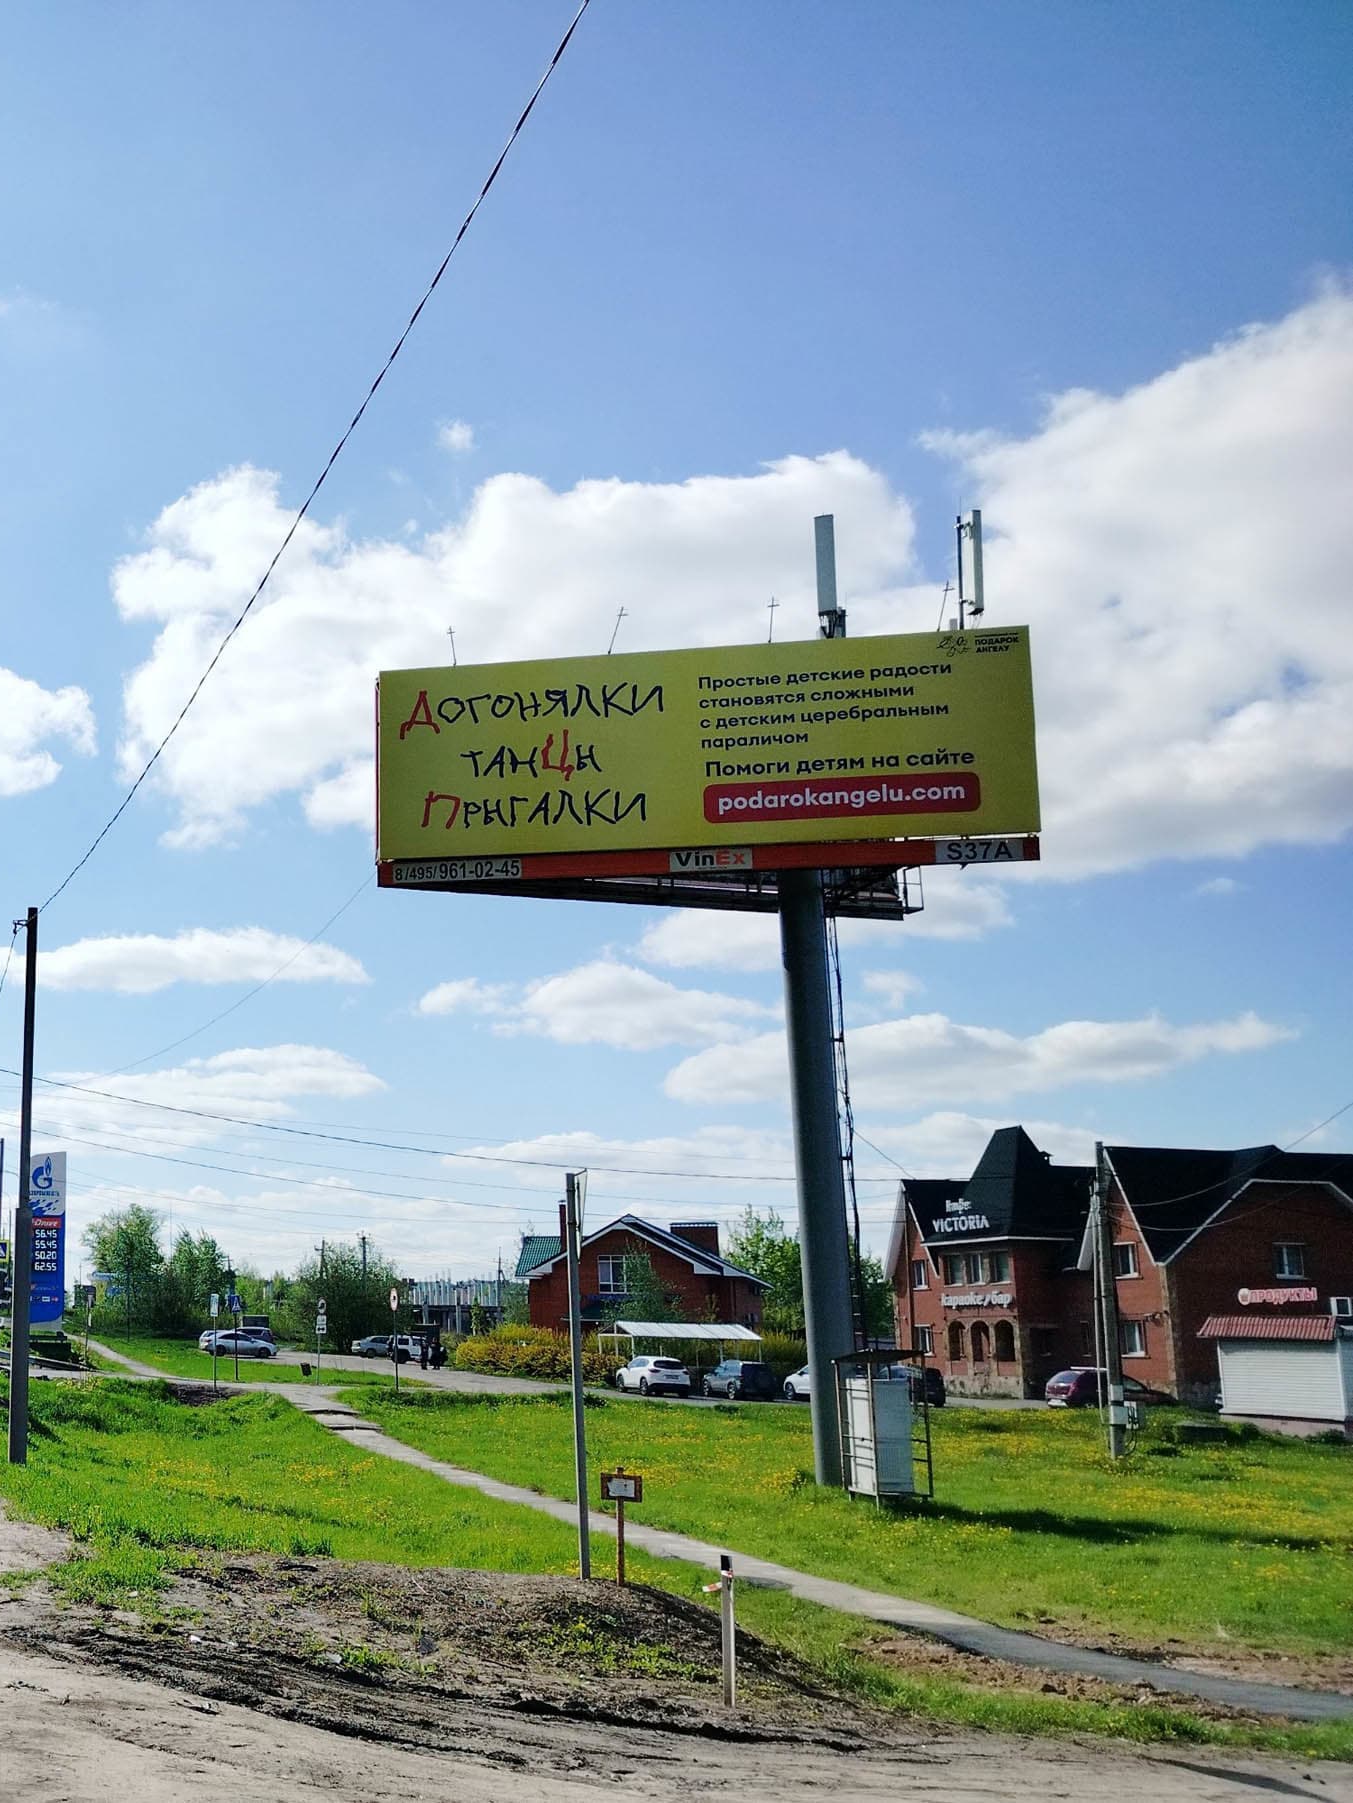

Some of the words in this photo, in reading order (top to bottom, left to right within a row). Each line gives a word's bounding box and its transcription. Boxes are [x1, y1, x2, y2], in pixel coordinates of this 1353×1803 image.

[974, 635, 1019, 645] ПОДАРОК
[975, 644, 1010, 653] АНГЕЛУ
[698, 674, 781, 692] Простые
[786, 668, 865, 685] детские
[869, 663, 952, 681] радости
[699, 692, 806, 709] становятся
[810, 686, 914, 702] сложными
[399, 681, 664, 740] ДОГОНЯЛКИ
[700, 719, 711, 728] с
[715, 713, 796, 730] детским
[800, 704, 949, 724] церебральным
[701, 733, 809, 751] параличом
[460, 729, 603, 782] ТАНЦЫ
[705, 761, 790, 777] Помоги
[796, 756, 865, 775] детям
[871, 755, 900, 768] на
[905, 748, 975, 766] сайте
[420, 788, 647, 830] ПРЫГАЛКИ
[718, 783, 966, 815] podarokangelu.com
[674, 851, 745, 867] VinEx
[946, 841, 1014, 861] S37A
[932, 1214, 990, 1233] VICTORIA
[1249, 1287, 1318, 1305] ПРОДУКТЫ
